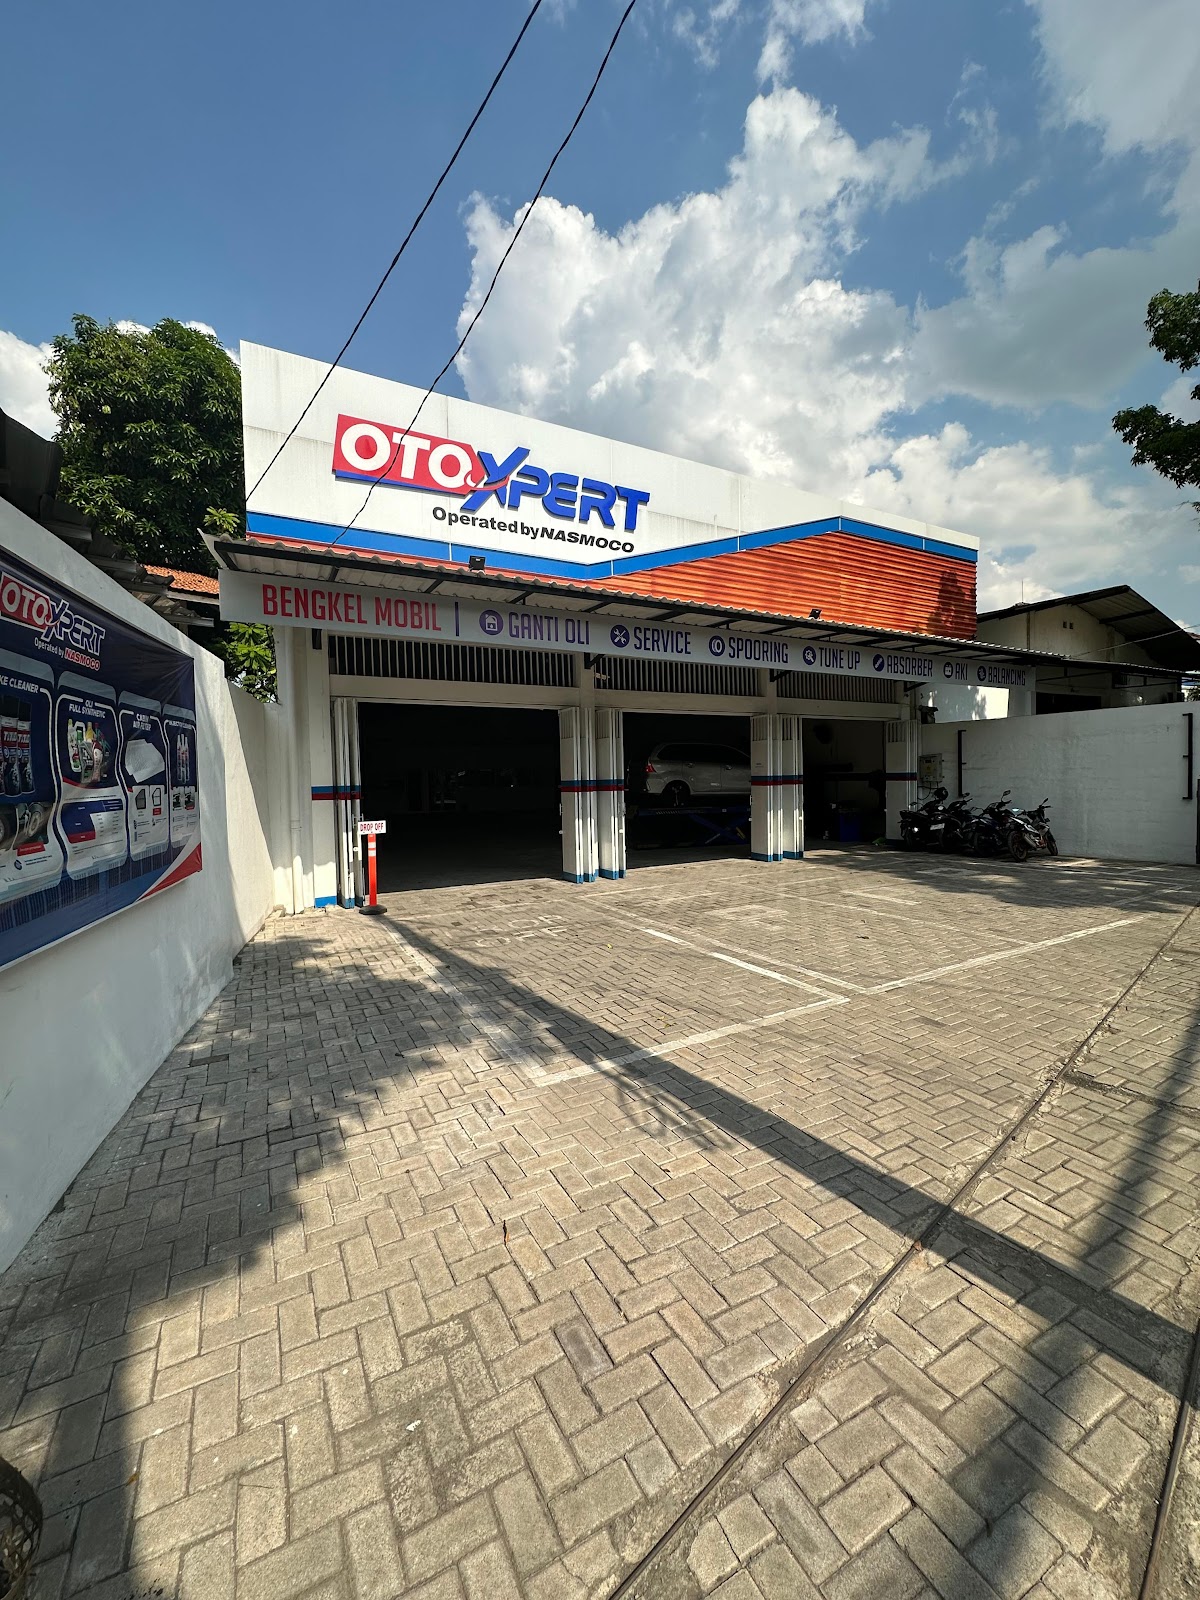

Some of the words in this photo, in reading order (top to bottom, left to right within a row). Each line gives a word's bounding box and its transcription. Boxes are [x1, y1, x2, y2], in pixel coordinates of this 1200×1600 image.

[432, 507, 518, 534] Operated
[520, 524, 539, 540] by
[540, 527, 635, 553] NASMOCO
[262, 583, 367, 625] BENGKEL
[375, 596, 442, 632] MOBIL
[508, 612, 559, 642] GANTI
[566, 618, 590, 645] OLI
[633, 626, 691, 654] SERVICE
[34, 637, 58, 655] Operated
[58, 647, 64, 659] by
[64, 647, 100, 671] NASMOCO
[728, 637, 788, 664] SPOORING
[819, 647, 844, 669] TUNE
[847, 651, 860, 670] UP
[887, 655, 933, 677] ABSORBER
[955, 663, 968, 680] AKI
[988, 666, 1026, 686] BALANCING
[9, 677, 39, 694] CLEANER
[69, 703, 81, 714] FULL
[360, 823, 373, 831] DROP
[375, 822, 384, 831] OFF
